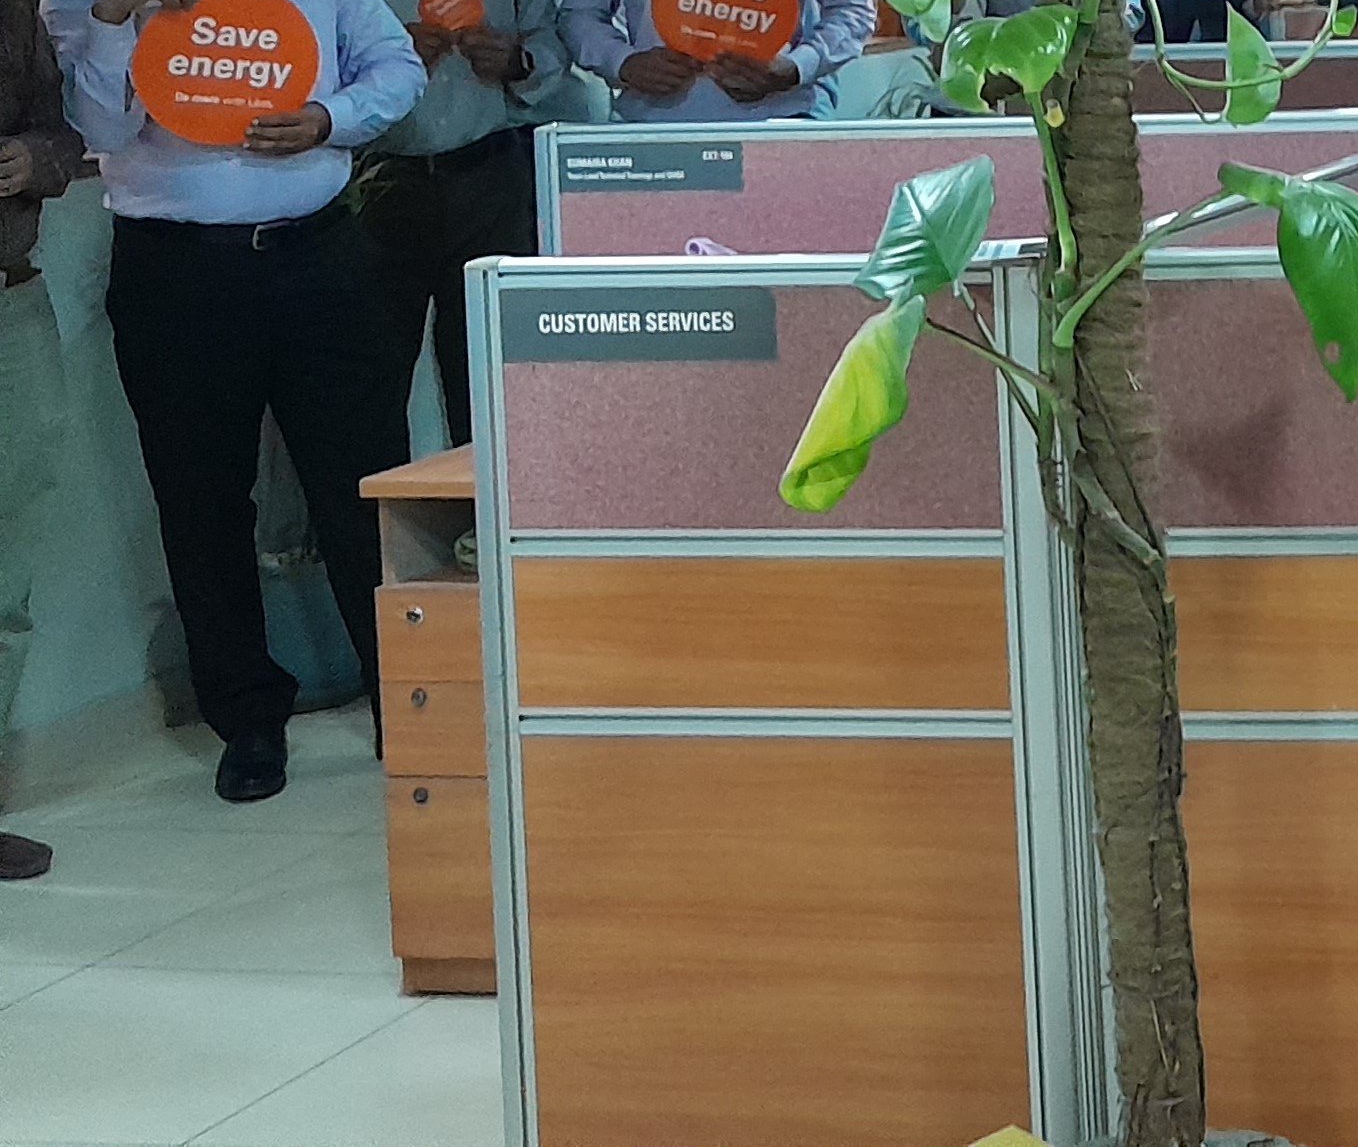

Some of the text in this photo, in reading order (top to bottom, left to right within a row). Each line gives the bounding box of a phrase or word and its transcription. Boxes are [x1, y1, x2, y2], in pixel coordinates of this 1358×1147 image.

[191, 16, 279, 50] Save
[168, 54, 293, 89] energy
[538, 311, 735, 334] CUSTOMER SERVICES
